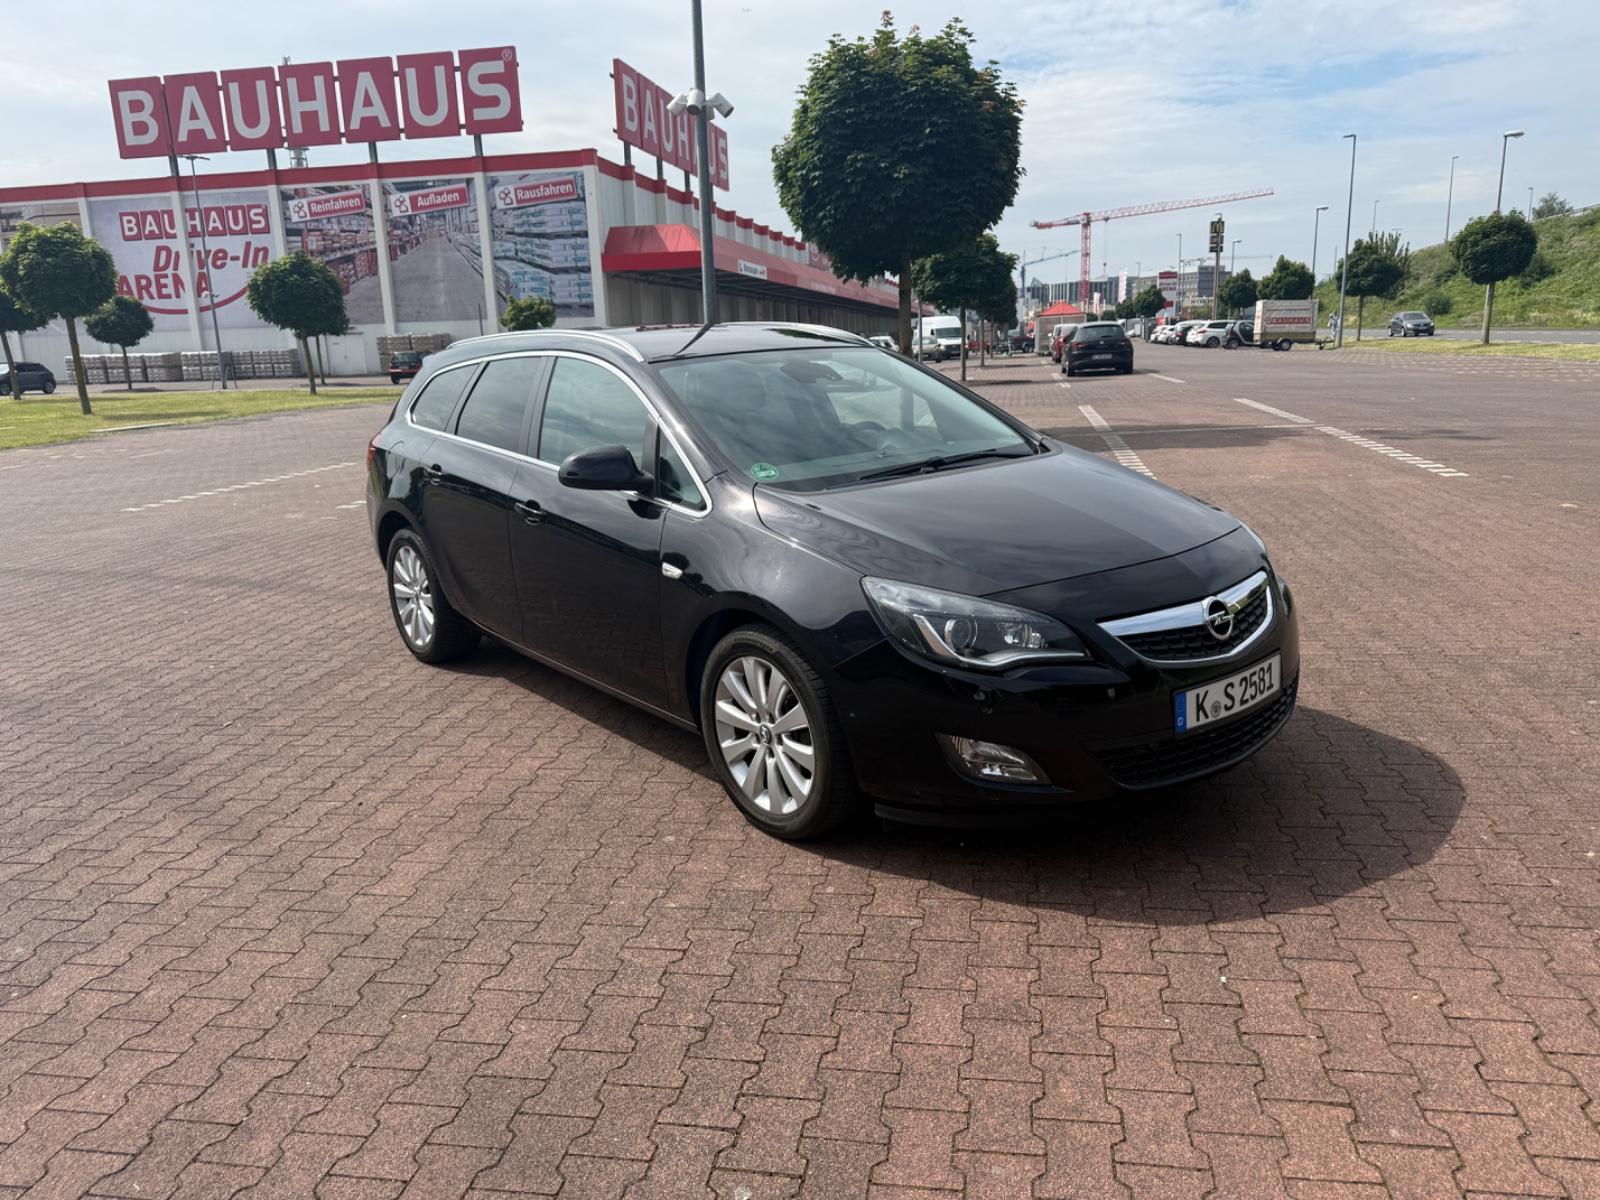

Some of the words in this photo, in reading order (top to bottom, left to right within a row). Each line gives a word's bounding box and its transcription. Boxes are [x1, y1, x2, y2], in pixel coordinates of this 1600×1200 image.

[117, 59, 513, 146] BAUHAUS
[417, 191, 460, 208] Aufladen
[516, 183, 574, 200] Rausfahren
[310, 196, 361, 214] Reinfahren
[1195, 689, 1210, 722] K
[1223, 681, 1236, 712] S
[1239, 662, 1275, 706] 2581
